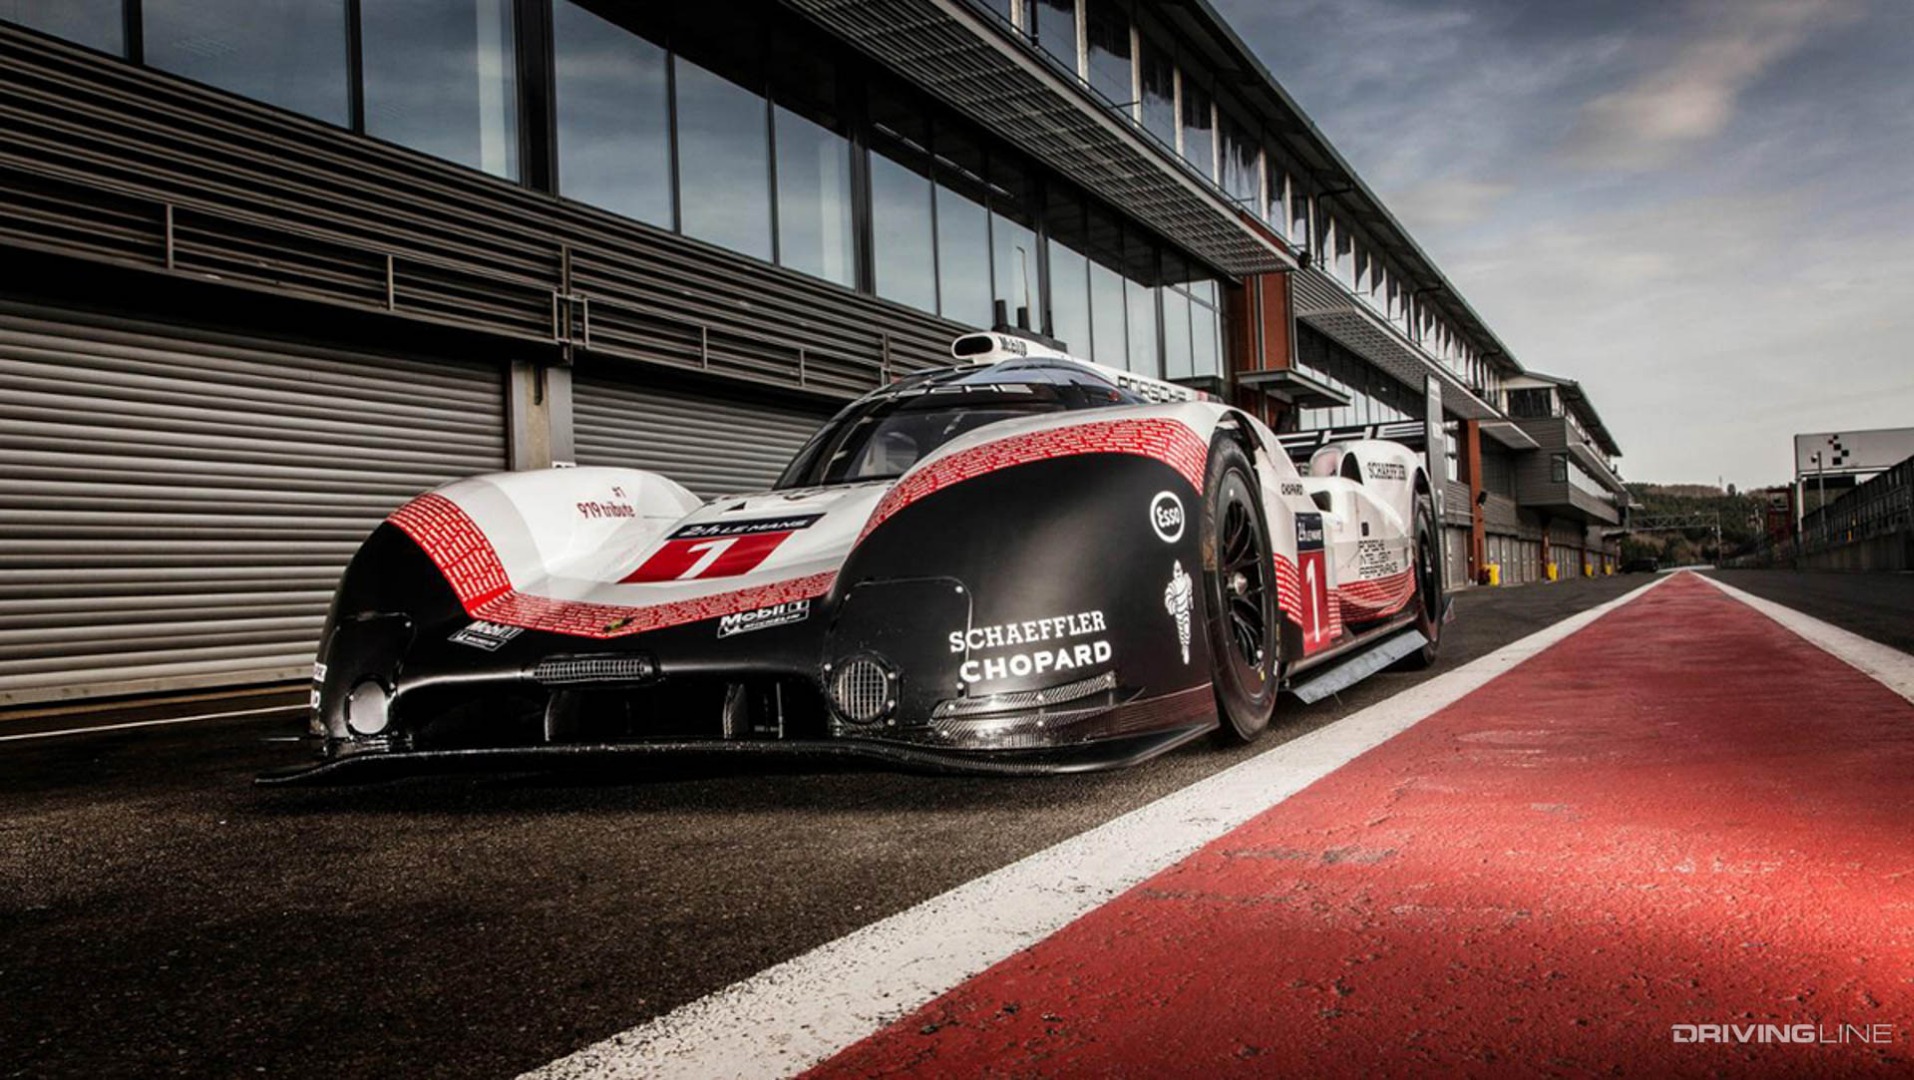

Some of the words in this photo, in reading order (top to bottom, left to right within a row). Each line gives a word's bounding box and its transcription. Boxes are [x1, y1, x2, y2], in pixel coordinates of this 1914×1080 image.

[1118, 376, 1187, 403] PORSCHE
[576, 501, 602, 519] 919
[601, 501, 636, 518] tribute
[1156, 505, 1180, 528] Esso
[674, 537, 740, 580] 1
[720, 603, 785, 628] Mobil
[1306, 559, 1320, 643] 1
[949, 610, 1107, 653] SCHAEFFLER
[959, 640, 1112, 683] CHOPARD
